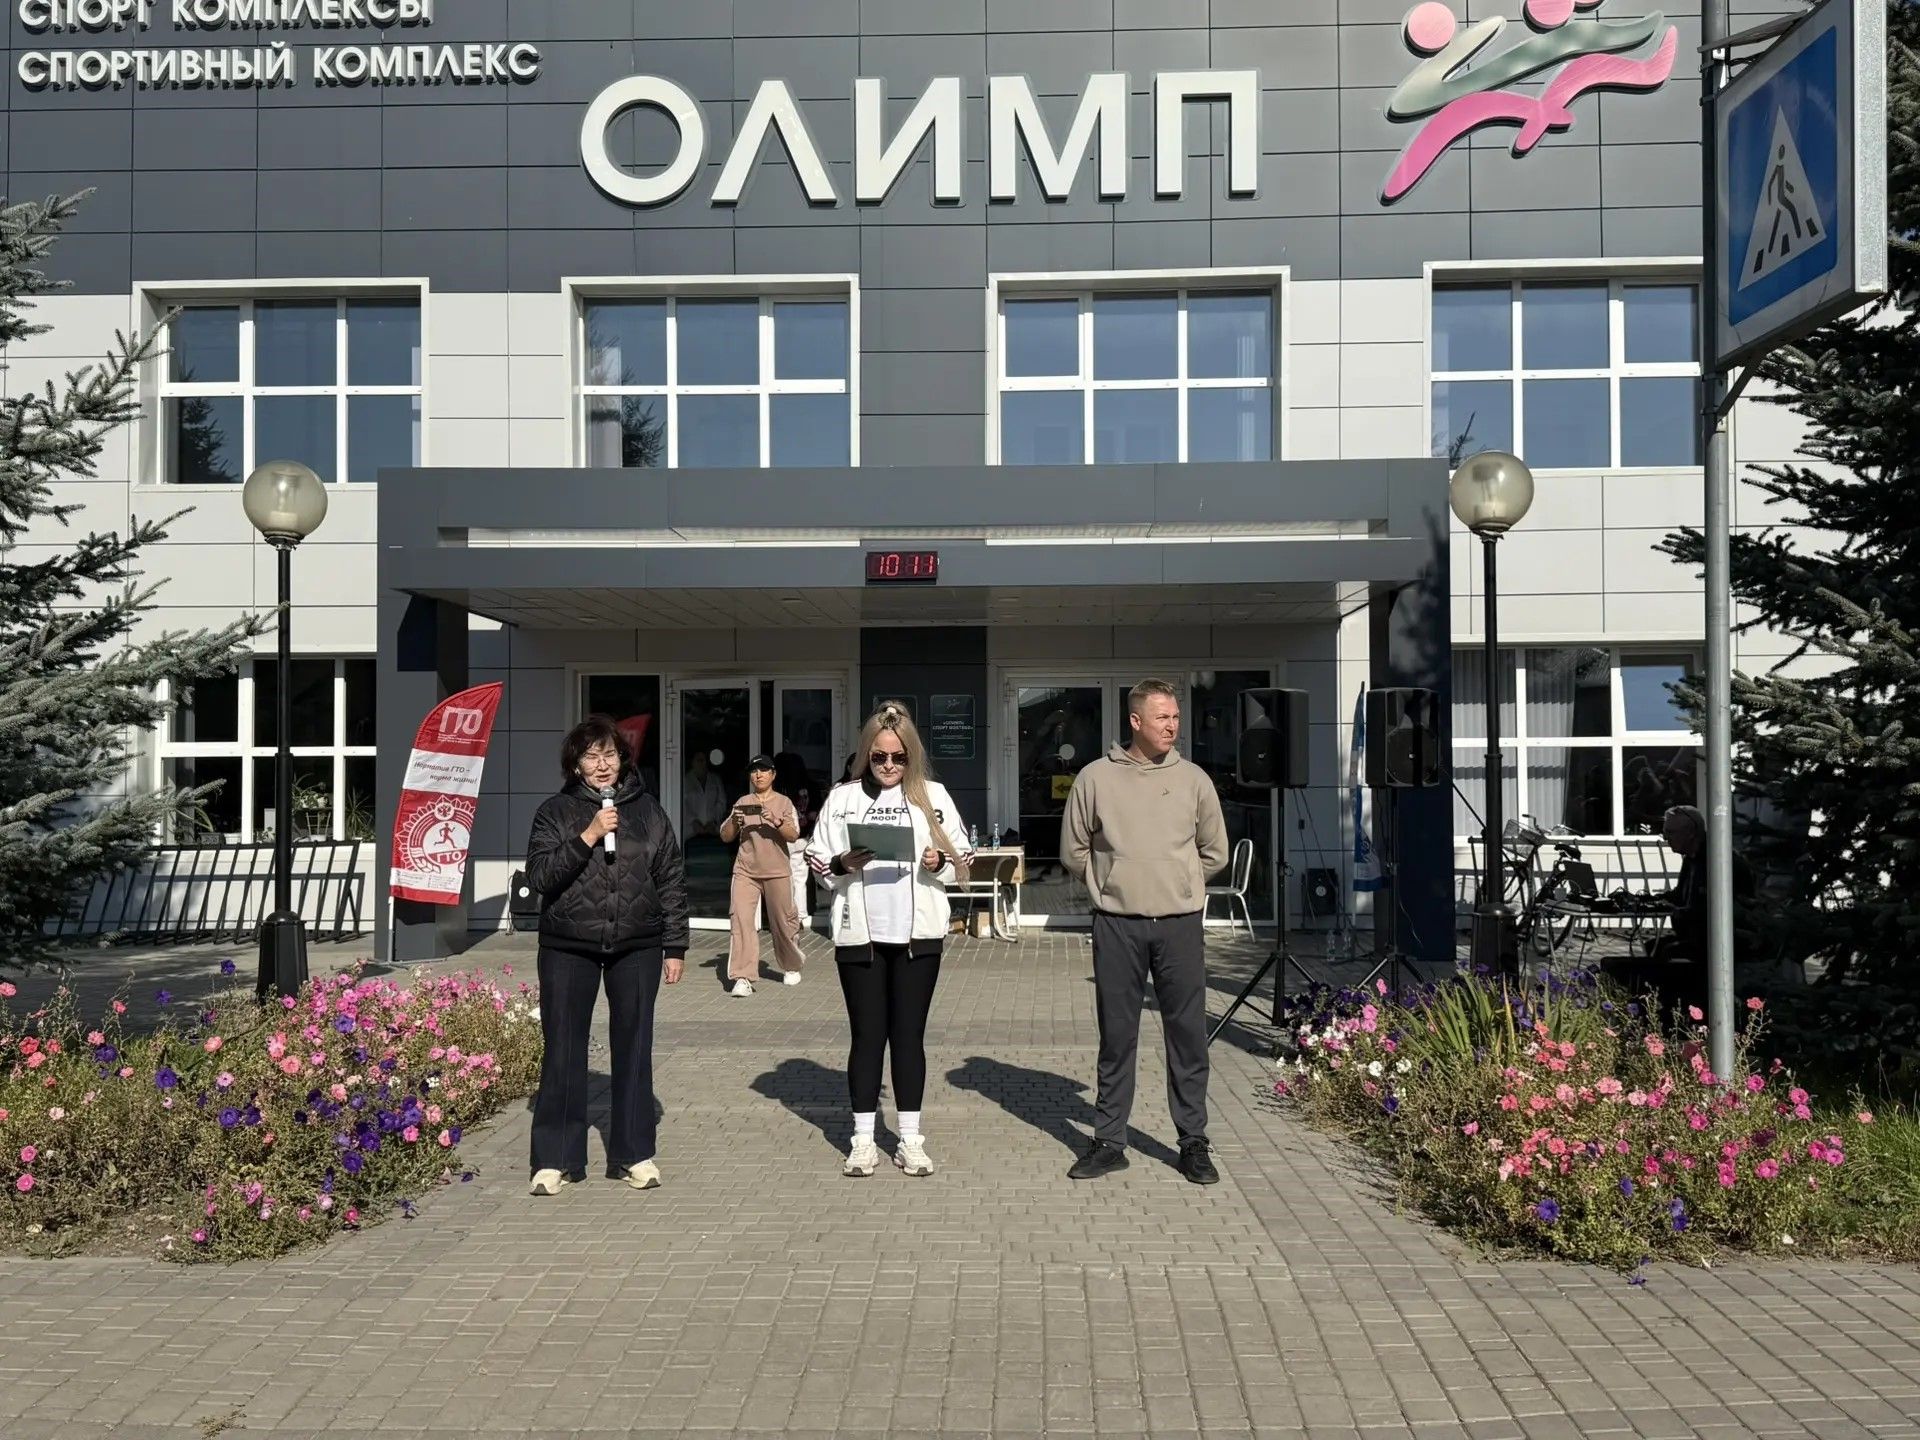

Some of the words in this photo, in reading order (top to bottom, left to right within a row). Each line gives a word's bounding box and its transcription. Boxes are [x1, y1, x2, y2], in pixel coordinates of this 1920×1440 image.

[19, 0, 147, 27] СПОРТ
[172, 0, 430, 26] КОМПЛЕКСЫ
[18, 41, 294, 86] СПОРТИВНЫЙ
[313, 43, 540, 82] КОМПЛЕКС
[580, 70, 1259, 206] ОЛИМП
[439, 706, 483, 734] ГТО
[451, 765, 465, 773] ГТО
[436, 851, 462, 863] ГТО
